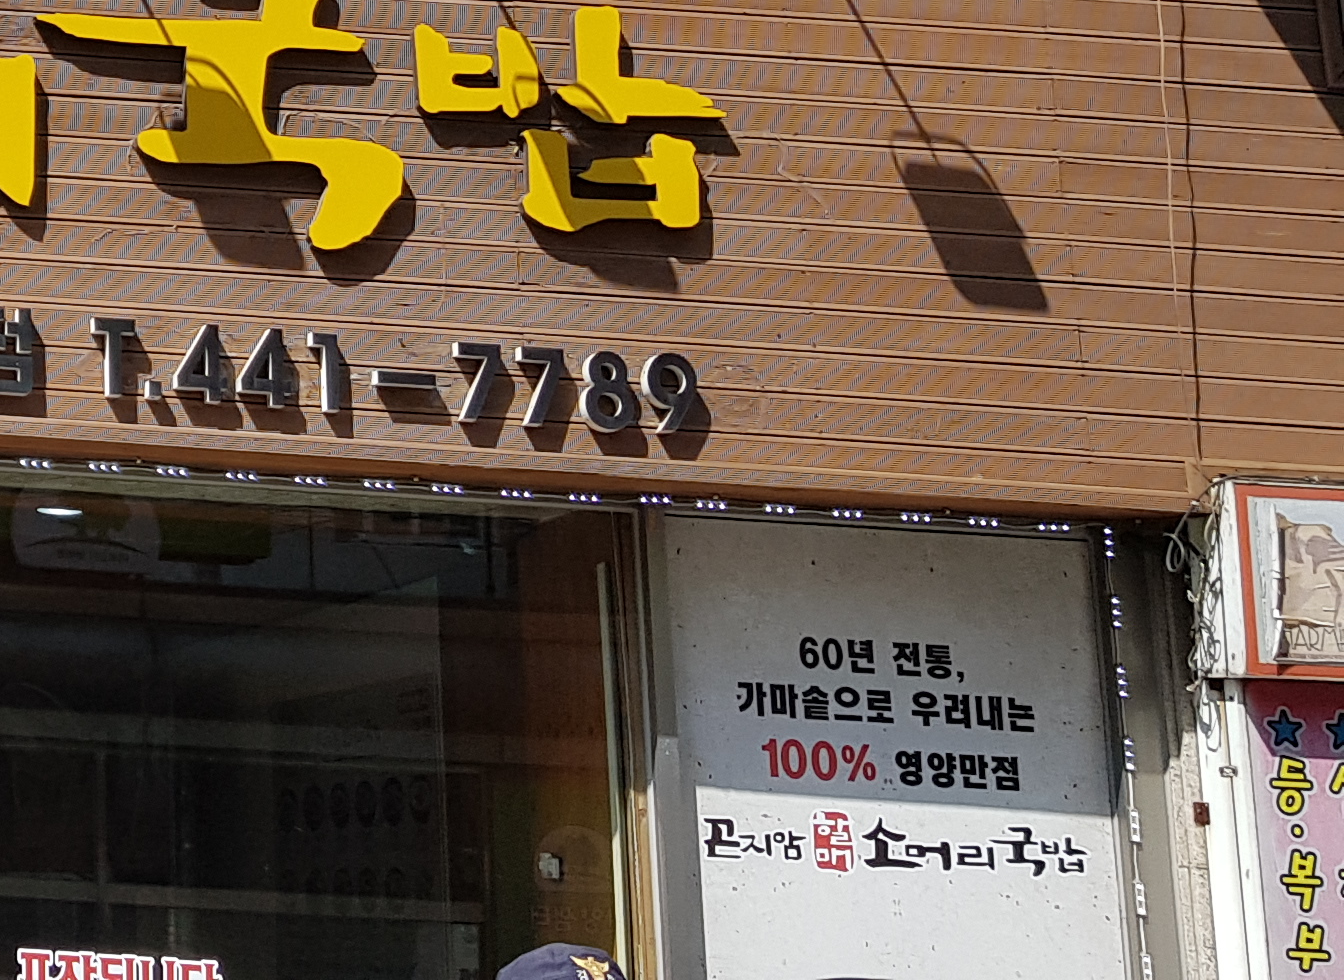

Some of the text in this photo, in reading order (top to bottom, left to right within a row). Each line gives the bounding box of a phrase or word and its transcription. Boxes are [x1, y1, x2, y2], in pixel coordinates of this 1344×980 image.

[88, 317, 700, 435] T.441-7789
[799, 636, 965, 683] 60년 전통,
[736, 680, 1036, 733] 가마솥으로 우려내는
[761, 738, 1021, 792] 100% 영양만점
[703, 811, 1088, 875] 곤지암 할매 소머리국밥
